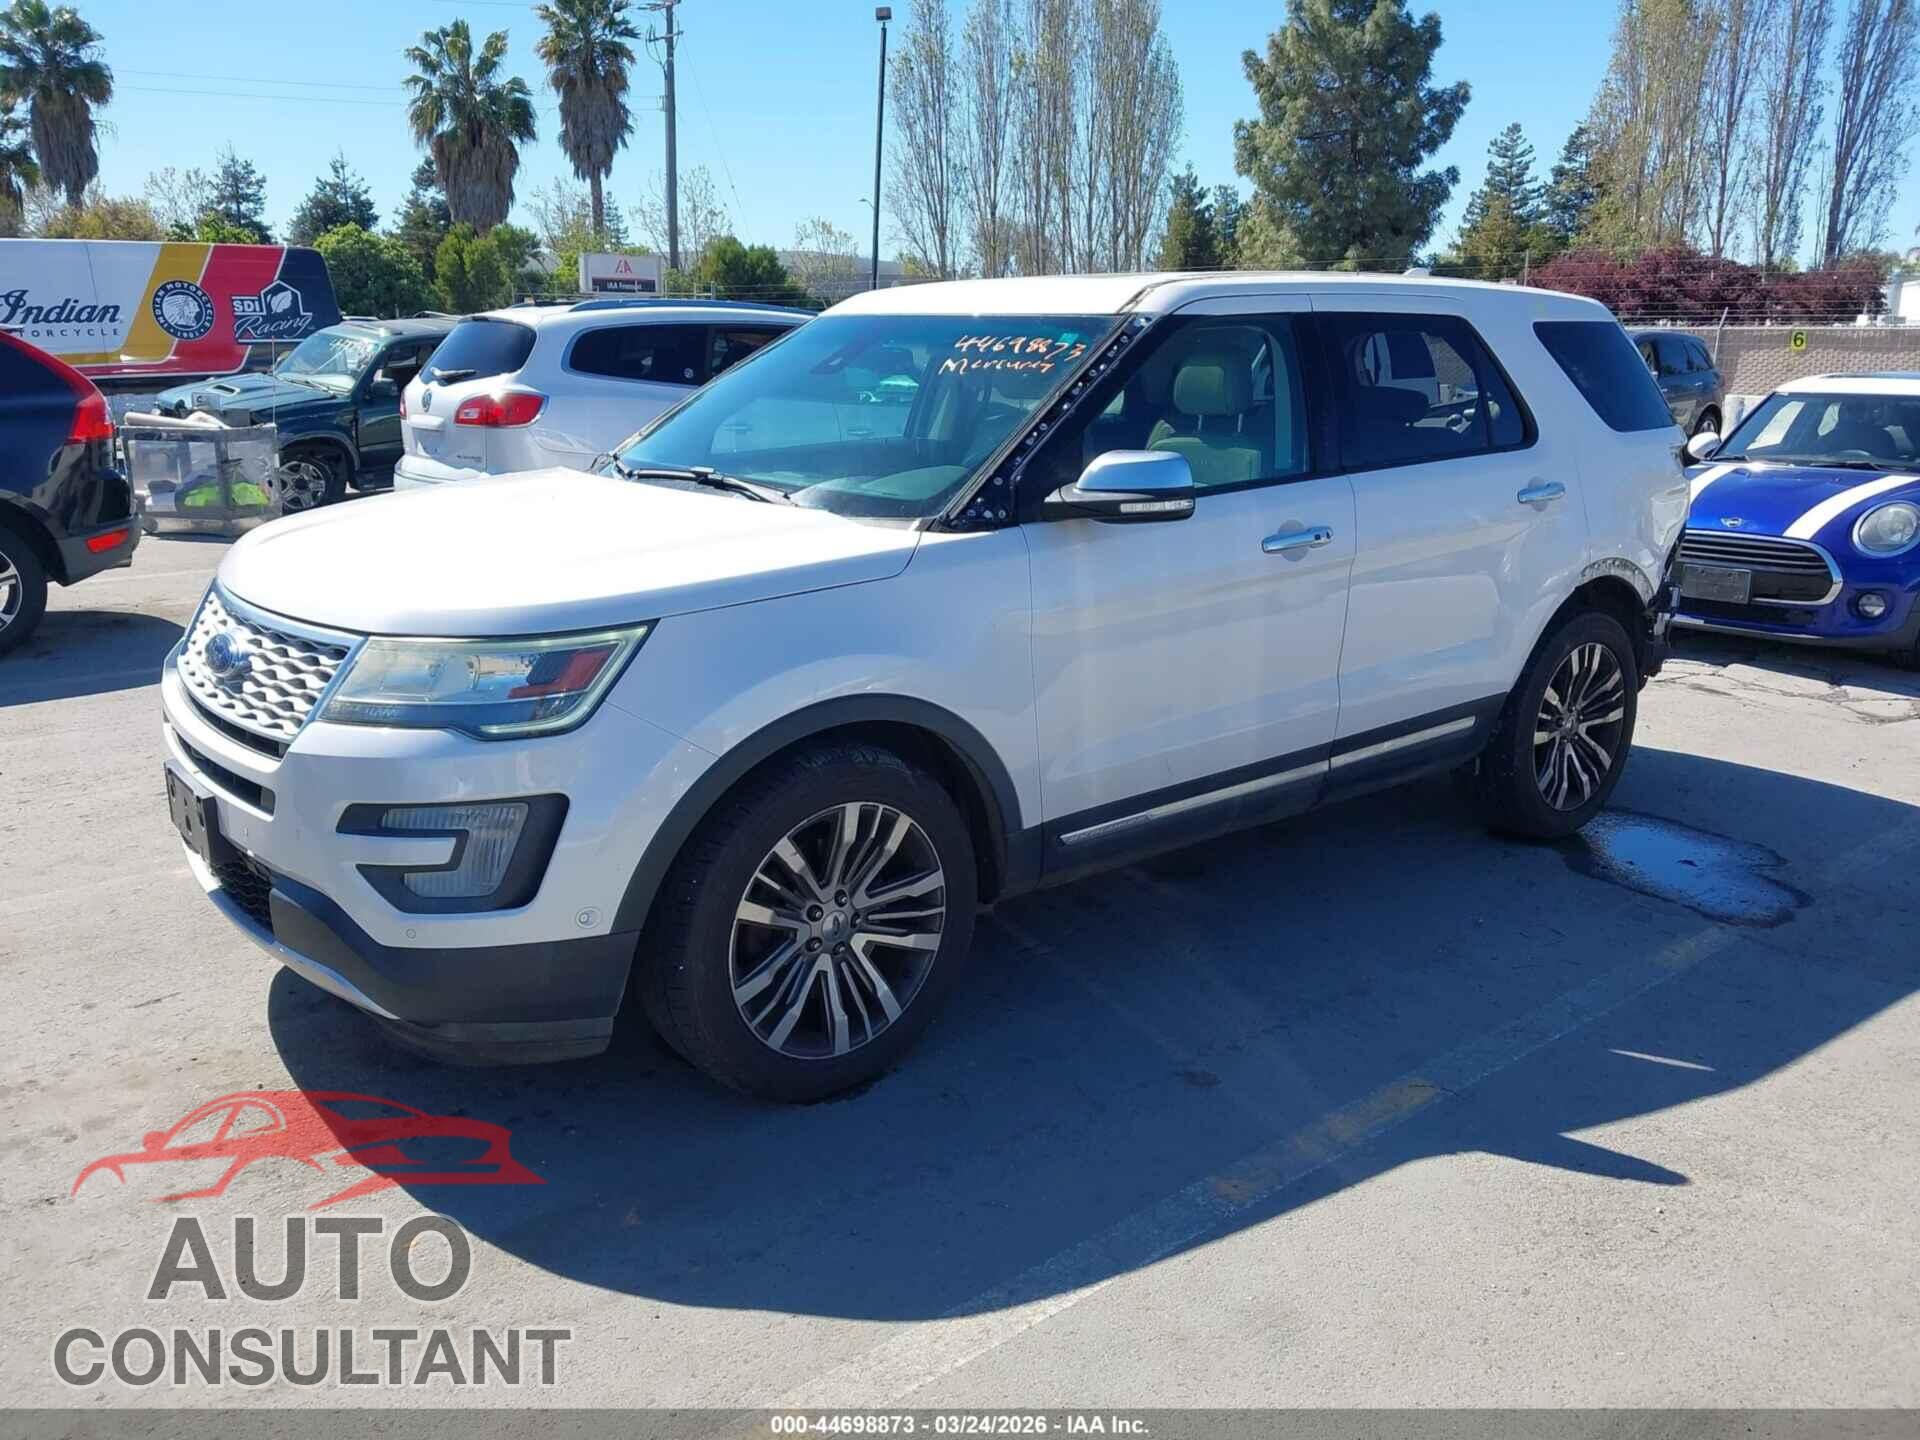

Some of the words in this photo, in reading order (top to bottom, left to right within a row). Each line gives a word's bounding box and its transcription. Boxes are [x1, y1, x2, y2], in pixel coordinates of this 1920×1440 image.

[0, 290, 121, 324] Indian
[154, 288, 169, 328] INDIAN
[166, 282, 213, 328] MOTORCYCLE
[233, 300, 260, 312] SDI
[18, 328, 120, 337] TORCYCLE
[234, 315, 312, 338] Racing
[1793, 331, 1805, 348] 6
